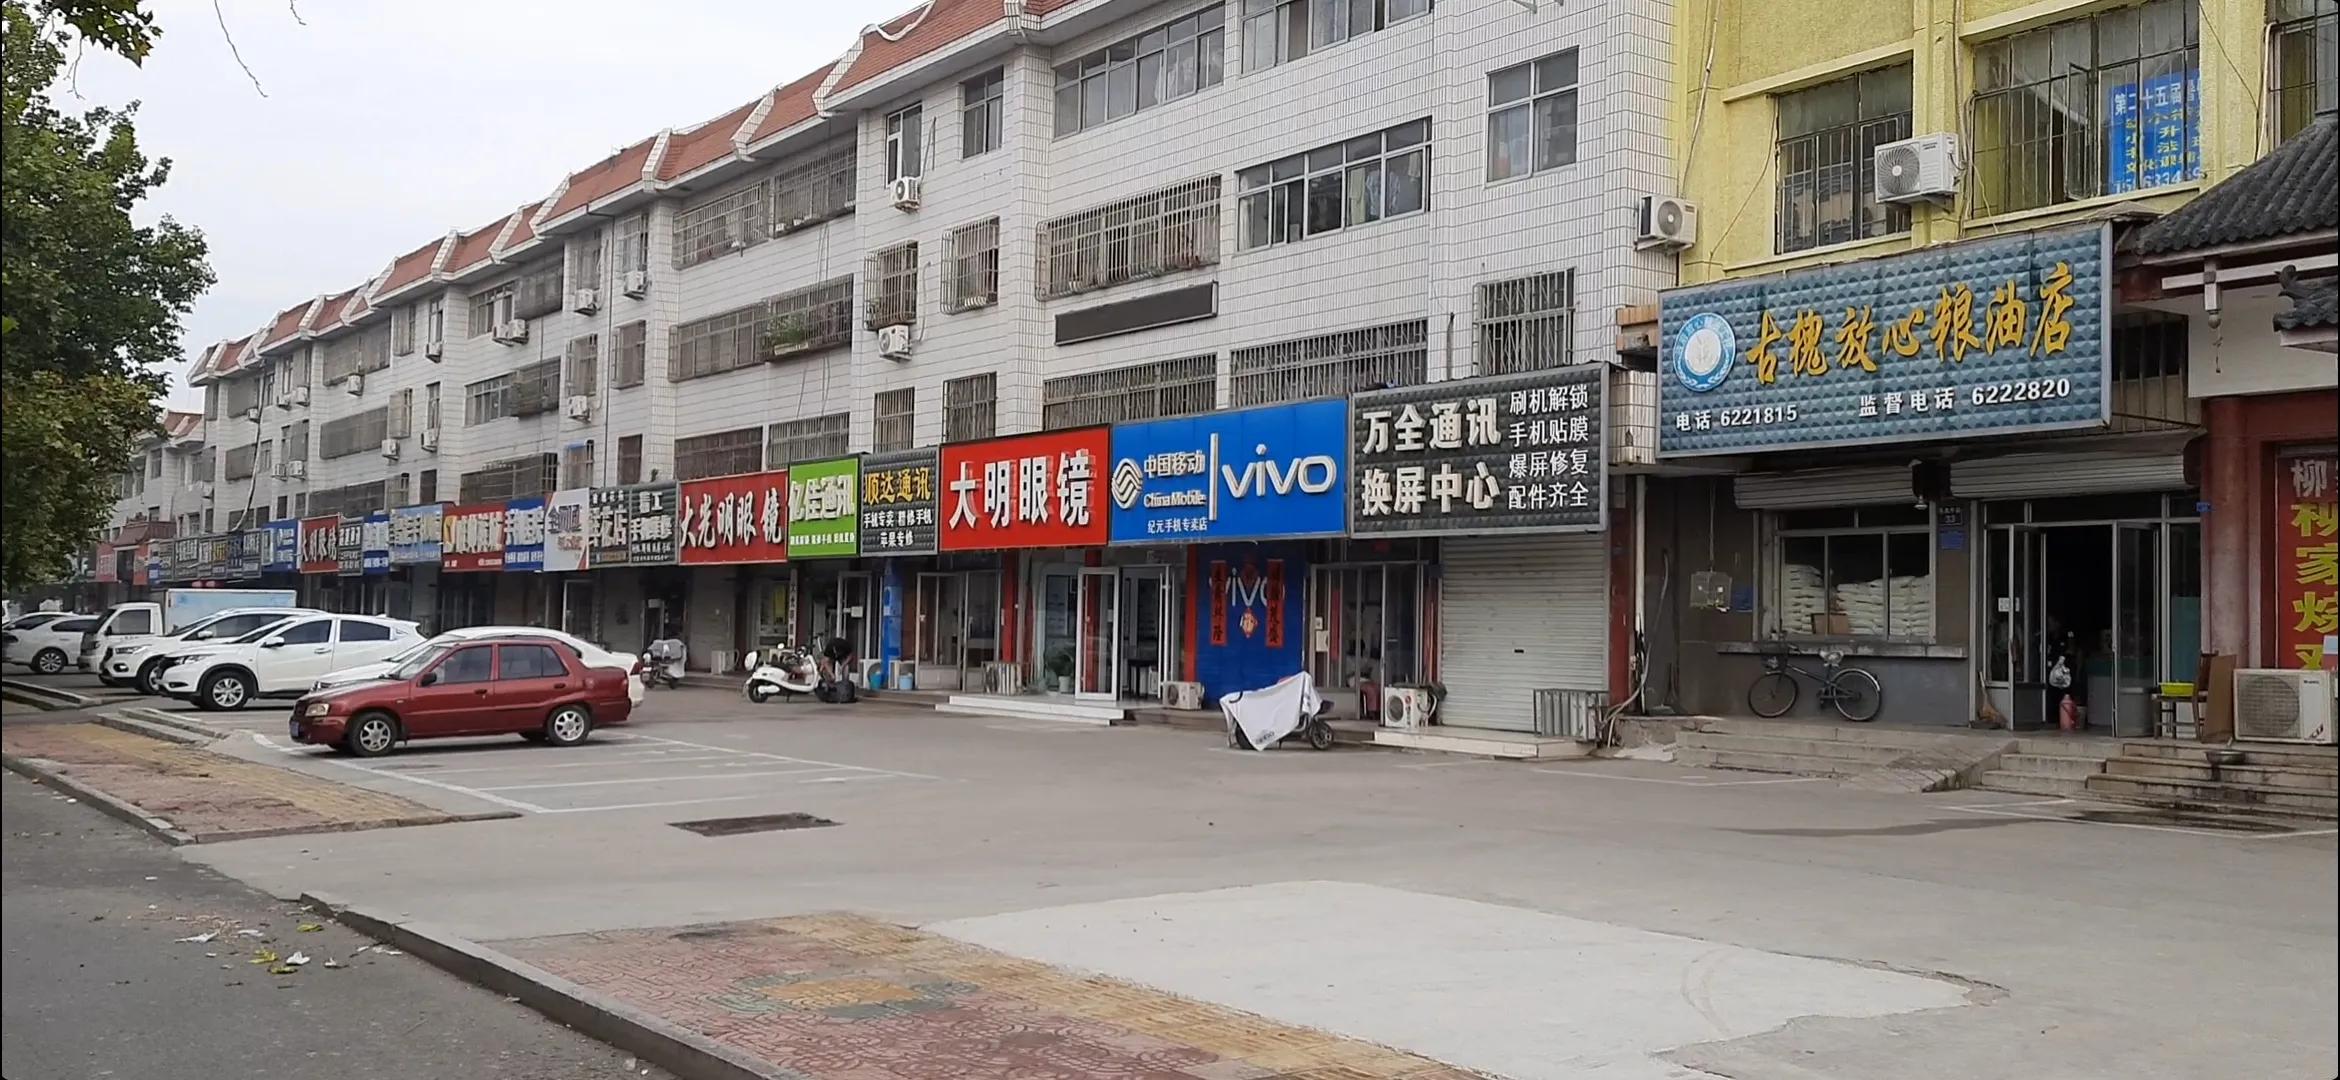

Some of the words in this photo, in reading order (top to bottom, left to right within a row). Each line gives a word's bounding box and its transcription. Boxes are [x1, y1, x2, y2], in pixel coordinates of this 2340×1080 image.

[1745, 262, 2076, 385] 古槐放心粮油店
[1509, 383, 1589, 415] 刷机解锁
[1858, 387, 1955, 417] 监督电话
[1971, 378, 2071, 406] 6222820
[1362, 398, 1501, 454] 万全通讯
[1508, 415, 1589, 447] 手机贴膜
[1676, 410, 1711, 431] 电话
[1720, 404, 1798, 427] 6221815
[1143, 450, 1206, 479] 中国移动
[1221, 443, 1337, 498] vivo
[1508, 448, 1589, 479] 爆屏修复
[863, 466, 931, 506] 顺达通讯
[949, 447, 1092, 529] 大明眼镜
[1143, 492, 1171, 508] China
[1171, 488, 1207, 507] Mobile
[1361, 461, 1500, 516] 换屏中心
[1508, 481, 1589, 510] 配件齐全
[680, 487, 782, 549] 大光明眼镜
[863, 510, 895, 528] 手机专卖
[1147, 516, 1208, 535] 纪元手机专卖店
[880, 529, 914, 548] 苹果专修
